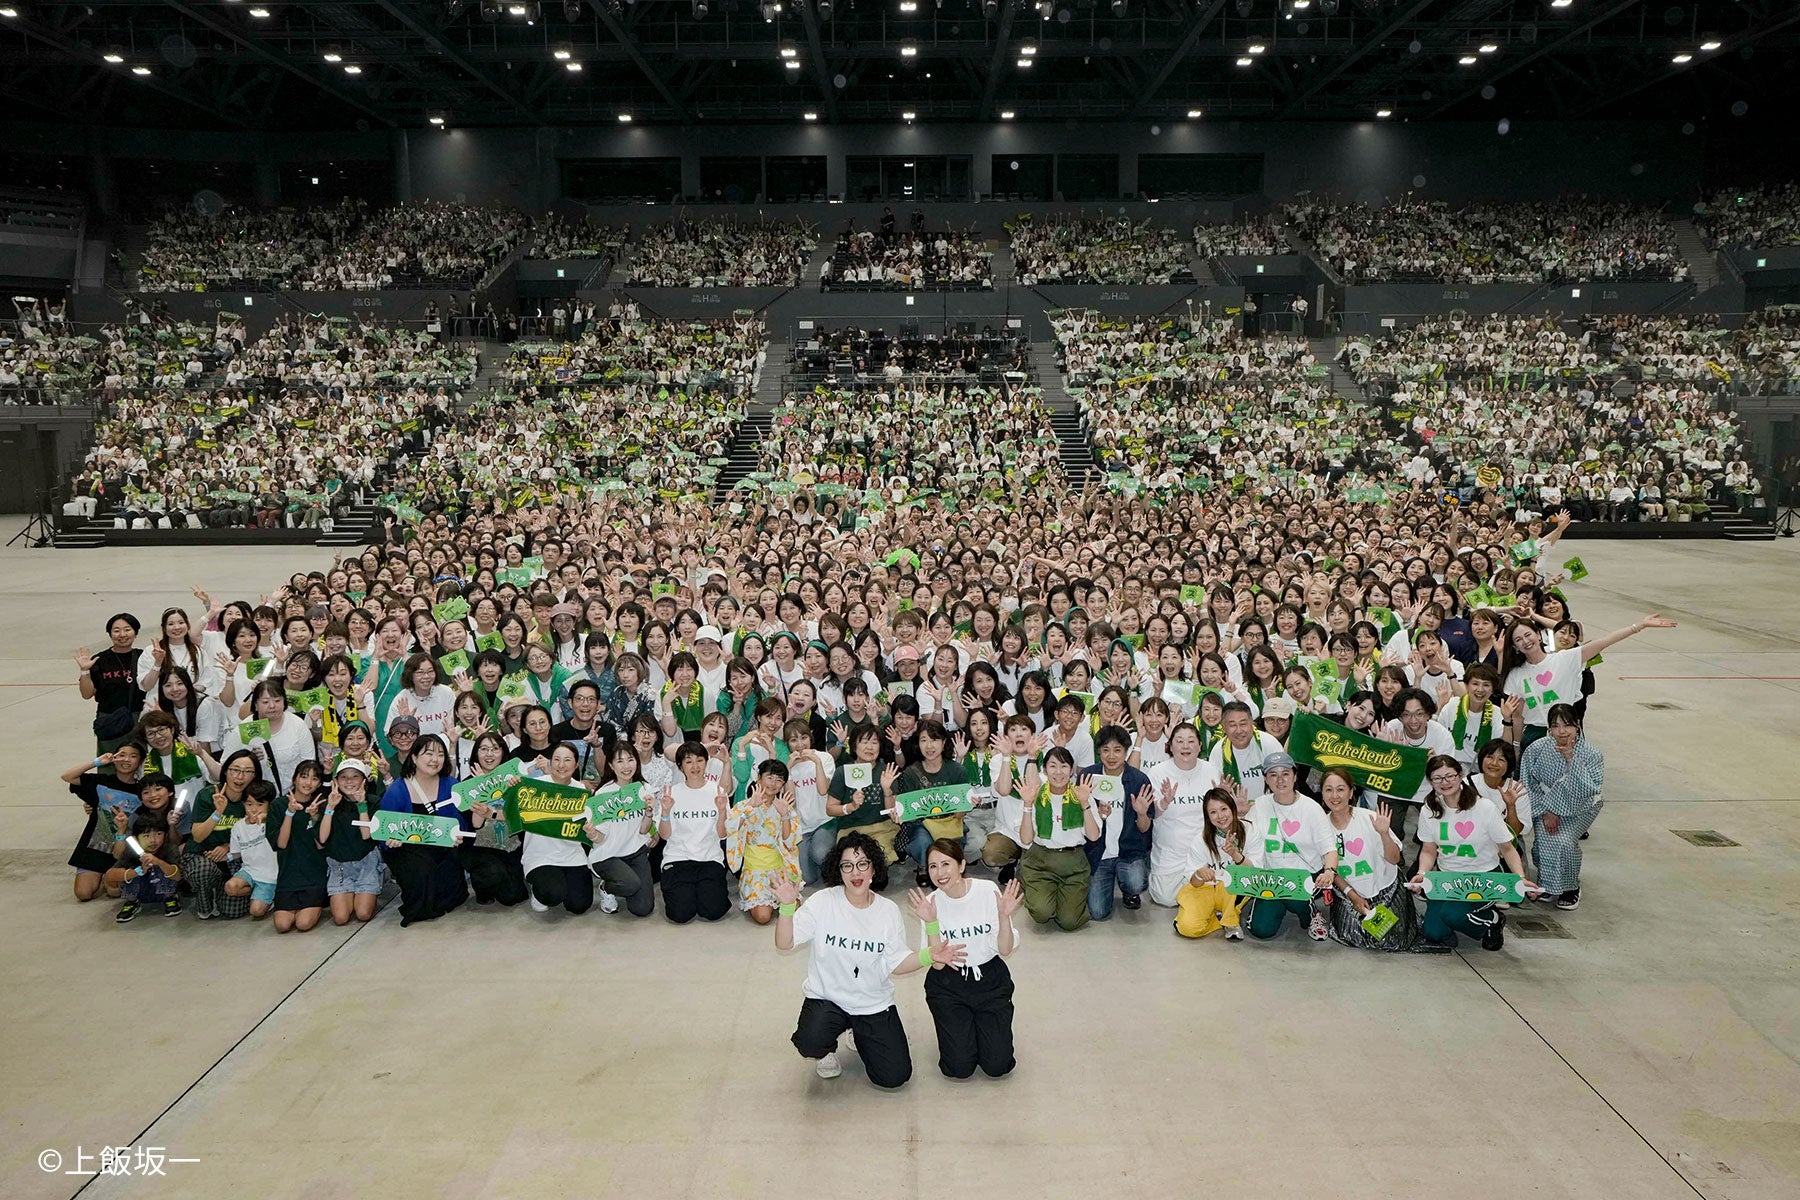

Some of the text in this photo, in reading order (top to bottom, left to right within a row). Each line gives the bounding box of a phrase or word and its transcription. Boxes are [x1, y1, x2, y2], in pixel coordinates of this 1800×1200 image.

[416, 711, 449, 723] KHND
[1366, 773, 1393, 792] 083
[517, 785, 588, 813] Makehend
[673, 809, 718, 820] MKHND
[1267, 818, 1278, 836] I
[1439, 821, 1450, 841] I
[1264, 839, 1300, 854] PA
[940, 923, 992, 940] MKHND
[825, 933, 885, 953] MKHND
